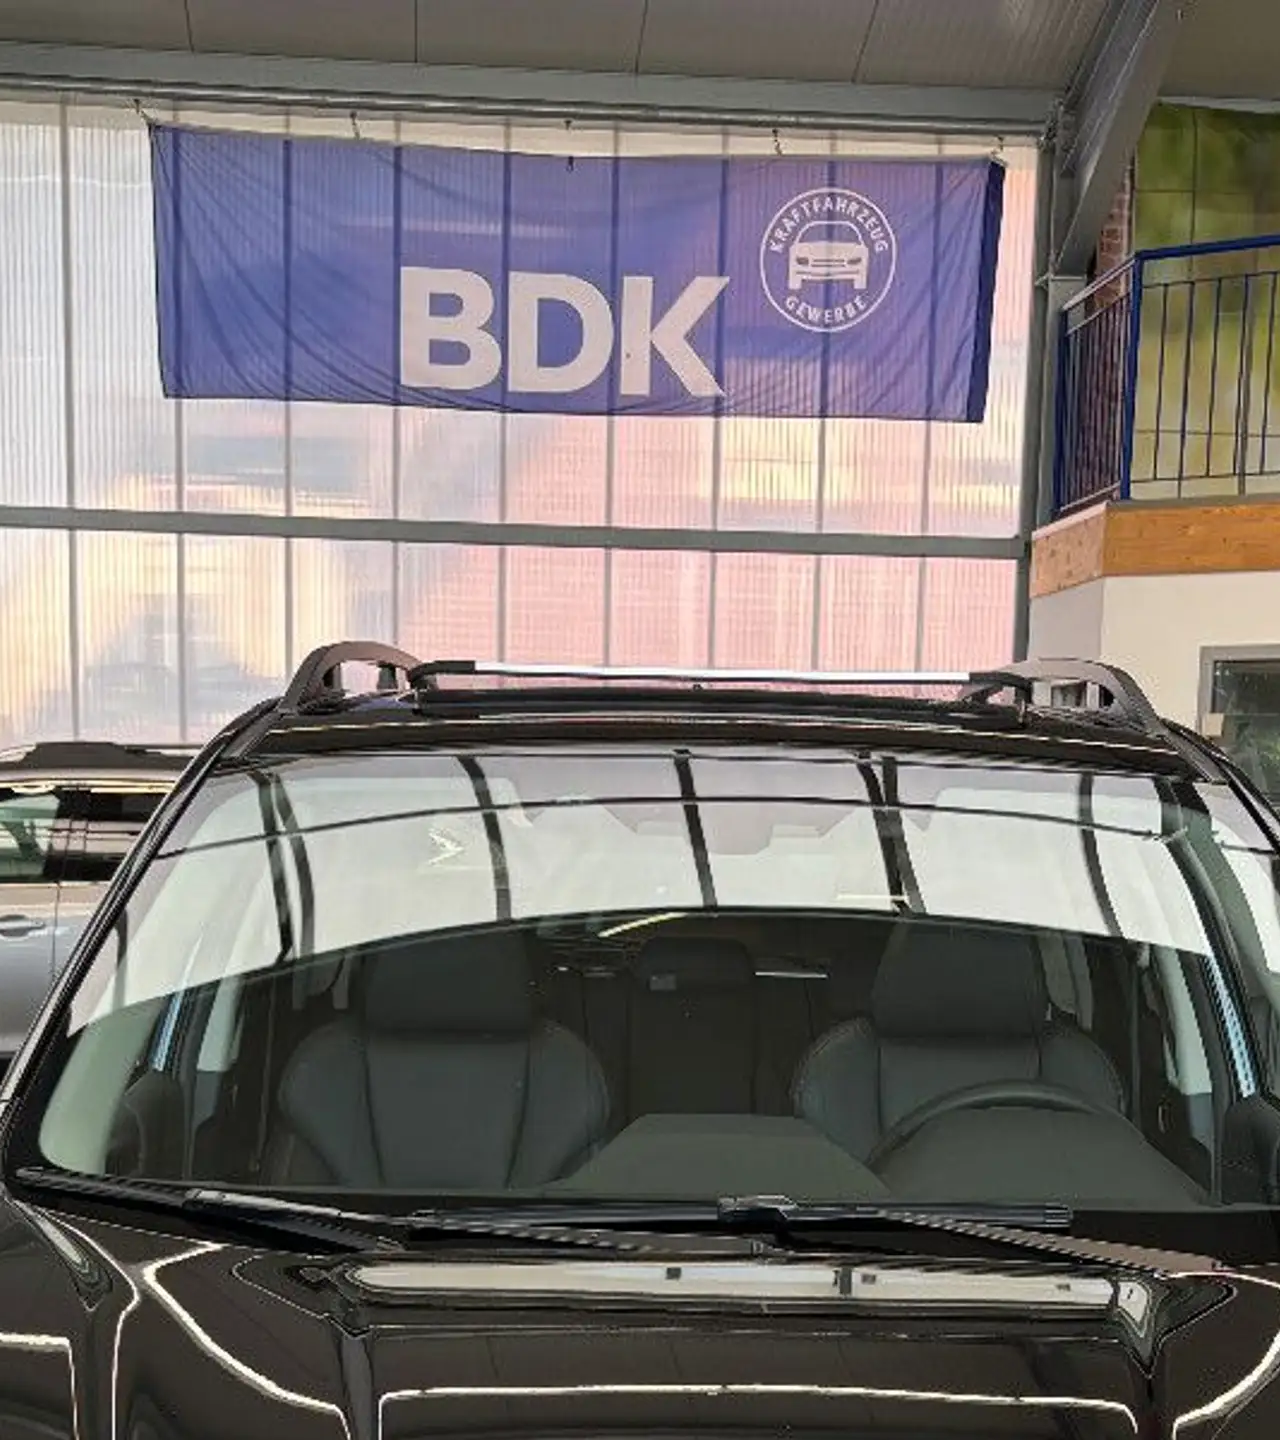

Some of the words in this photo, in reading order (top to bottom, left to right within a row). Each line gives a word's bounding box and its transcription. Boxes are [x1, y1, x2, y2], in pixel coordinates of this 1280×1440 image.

[770, 197, 889, 253] KRAFTFAHRZEUG
[400, 266, 730, 398] BDK
[786, 295, 867, 324] GEWERBE
